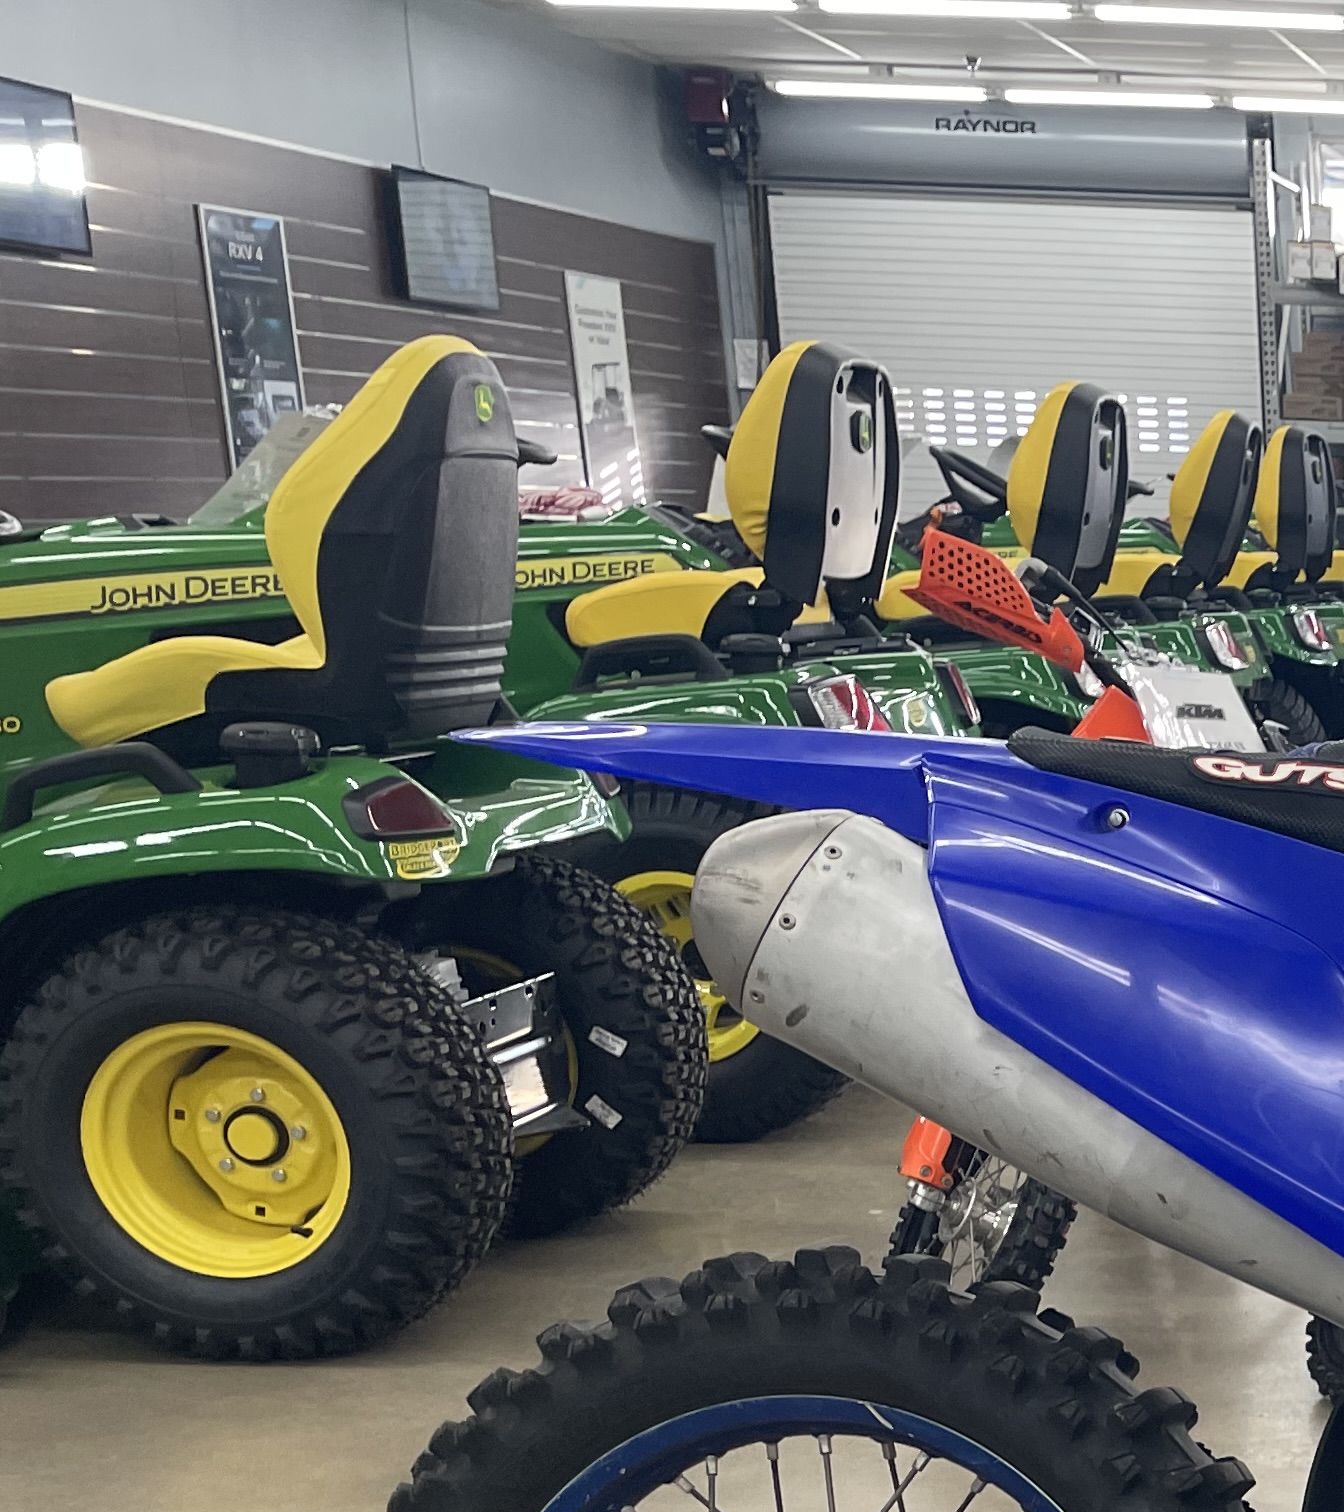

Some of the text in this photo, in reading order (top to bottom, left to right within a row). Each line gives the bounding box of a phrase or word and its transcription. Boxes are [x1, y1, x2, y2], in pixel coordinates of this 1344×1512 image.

[935, 117, 1037, 133] RAYNOR
[515, 558, 655, 585] OHN DEERE
[90, 582, 176, 611] JOHN
[1176, 703, 1226, 720] KTM
